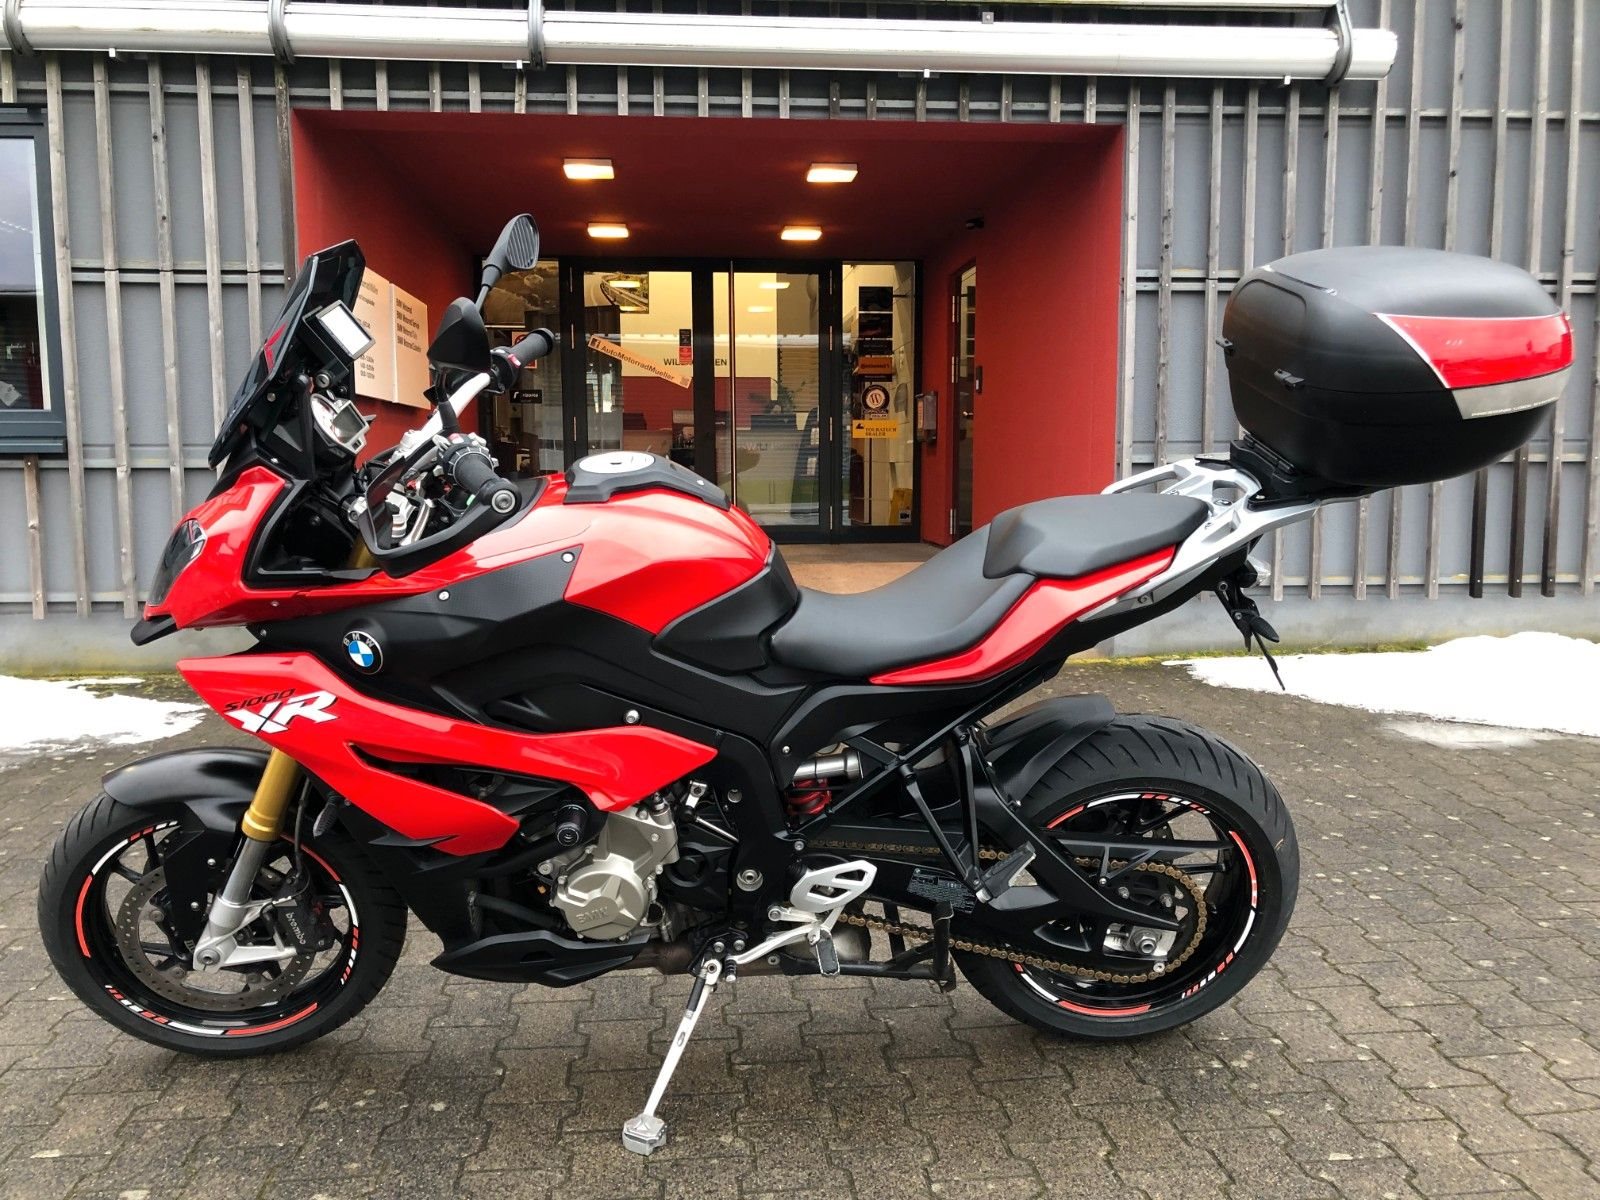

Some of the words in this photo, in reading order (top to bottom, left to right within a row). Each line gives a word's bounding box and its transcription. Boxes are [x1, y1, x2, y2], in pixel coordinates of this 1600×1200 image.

[601, 345, 674, 381] AutoMotorradMueller
[343, 633, 375, 647] BMW
[224, 690, 340, 734] XR
[225, 688, 296, 712] S1000
[286, 912, 306, 944] brembo
[575, 906, 608, 923] BMW
